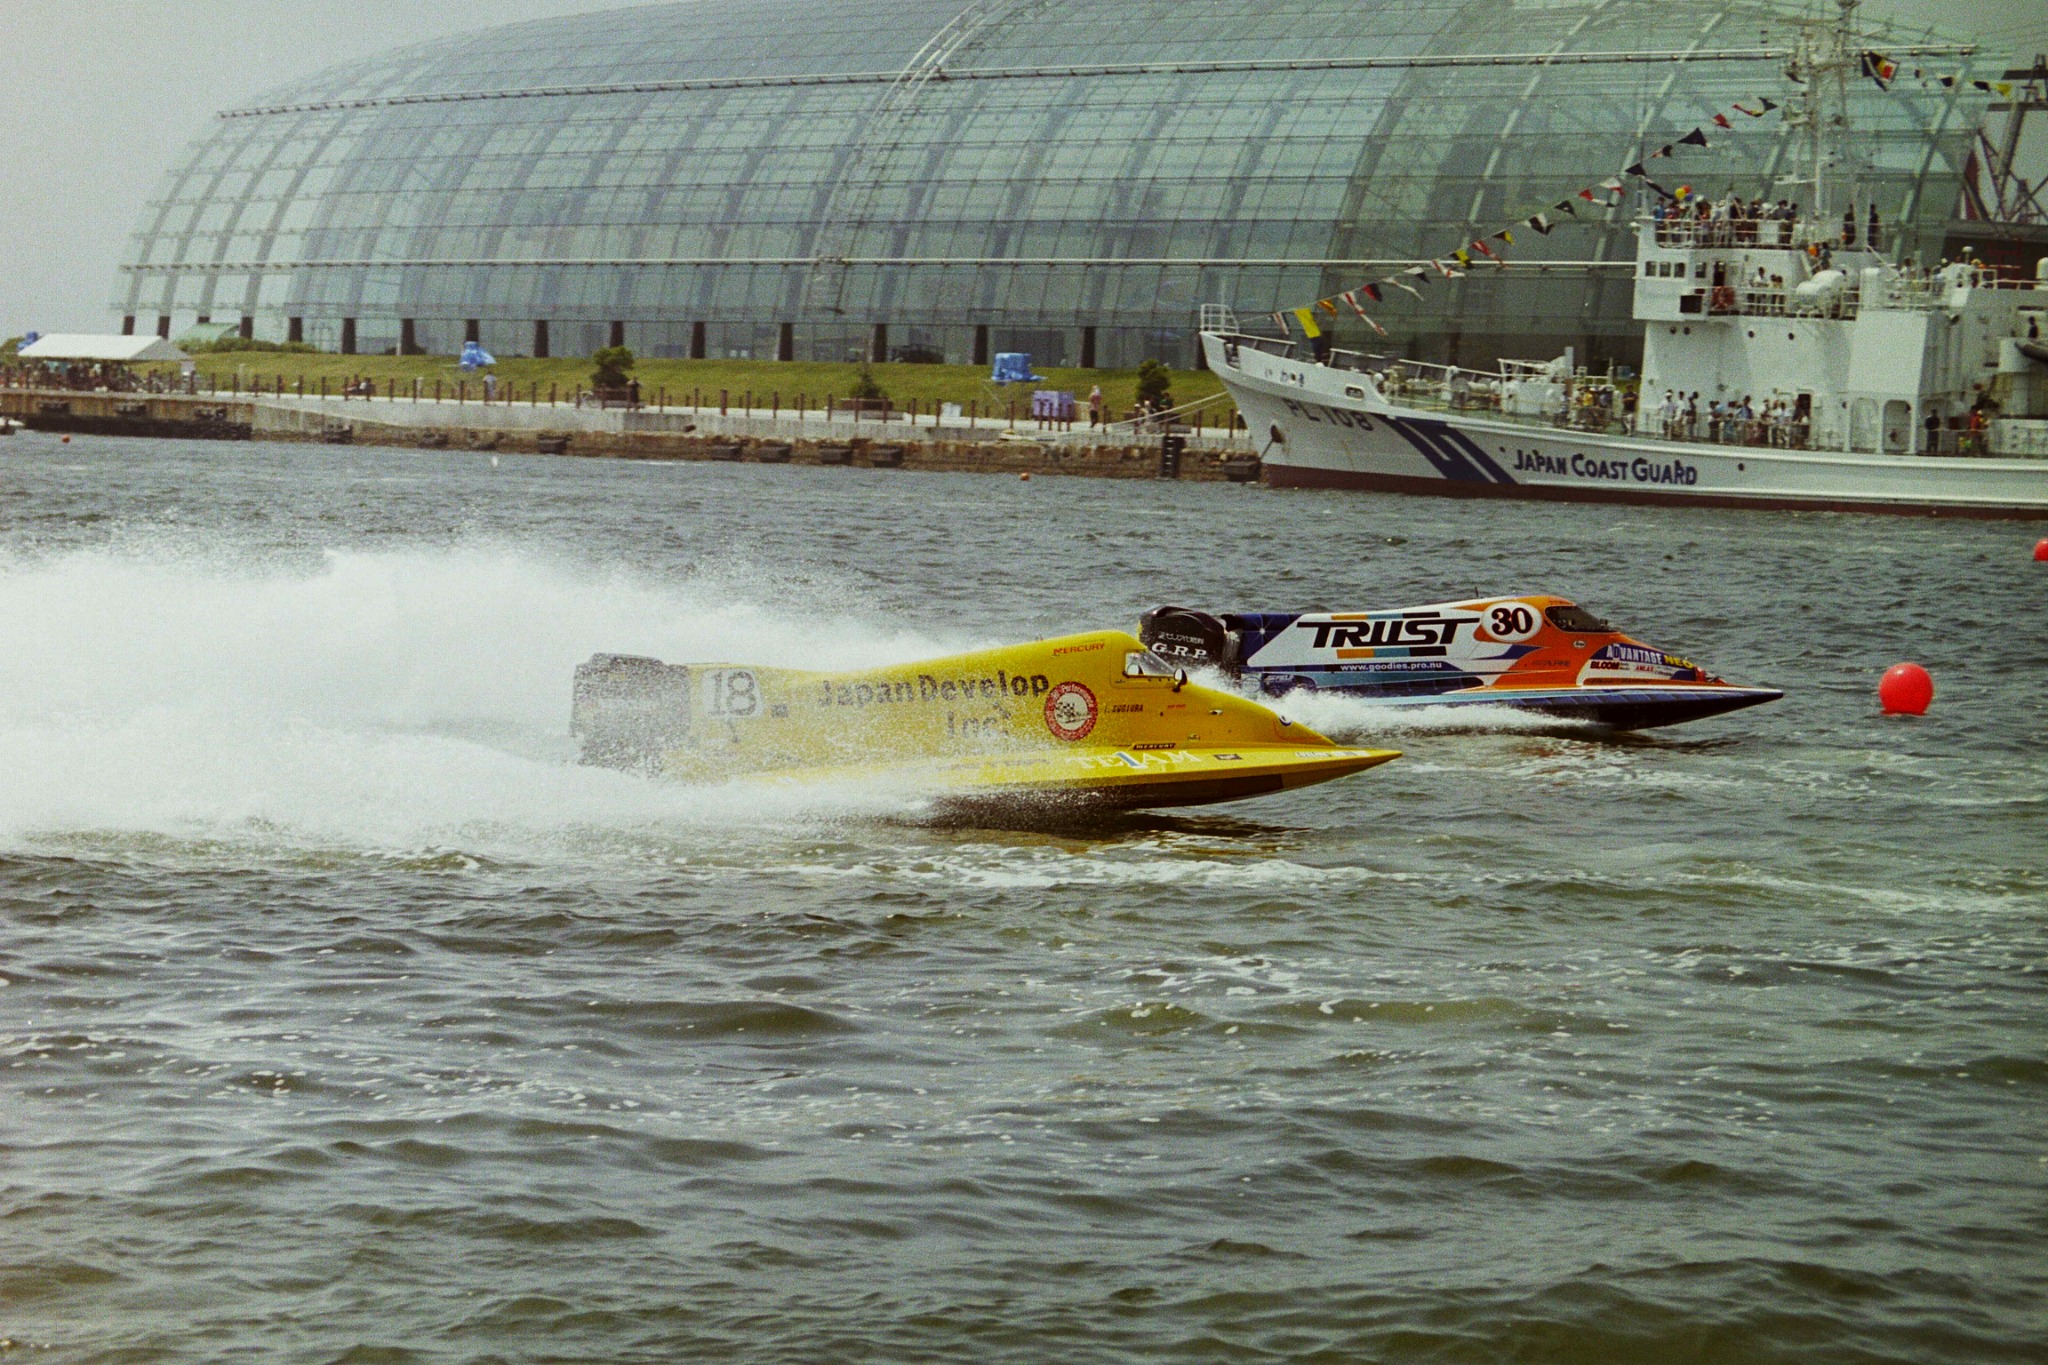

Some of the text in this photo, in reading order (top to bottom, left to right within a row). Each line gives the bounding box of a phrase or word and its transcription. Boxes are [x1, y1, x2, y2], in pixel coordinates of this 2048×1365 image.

[1297, 617, 1480, 648] TRUST
[1491, 607, 1533, 636] 30
[1053, 643, 1105, 656] MERCURY
[1606, 643, 1663, 665] ADVANTAGE
[1340, 662, 1442, 672] www.goodies.pro.nu
[1590, 661, 1619, 669] BLOOM
[708, 671, 756, 716] 18
[818, 681, 913, 707] Japan
[918, 670, 1049, 701] Develop
